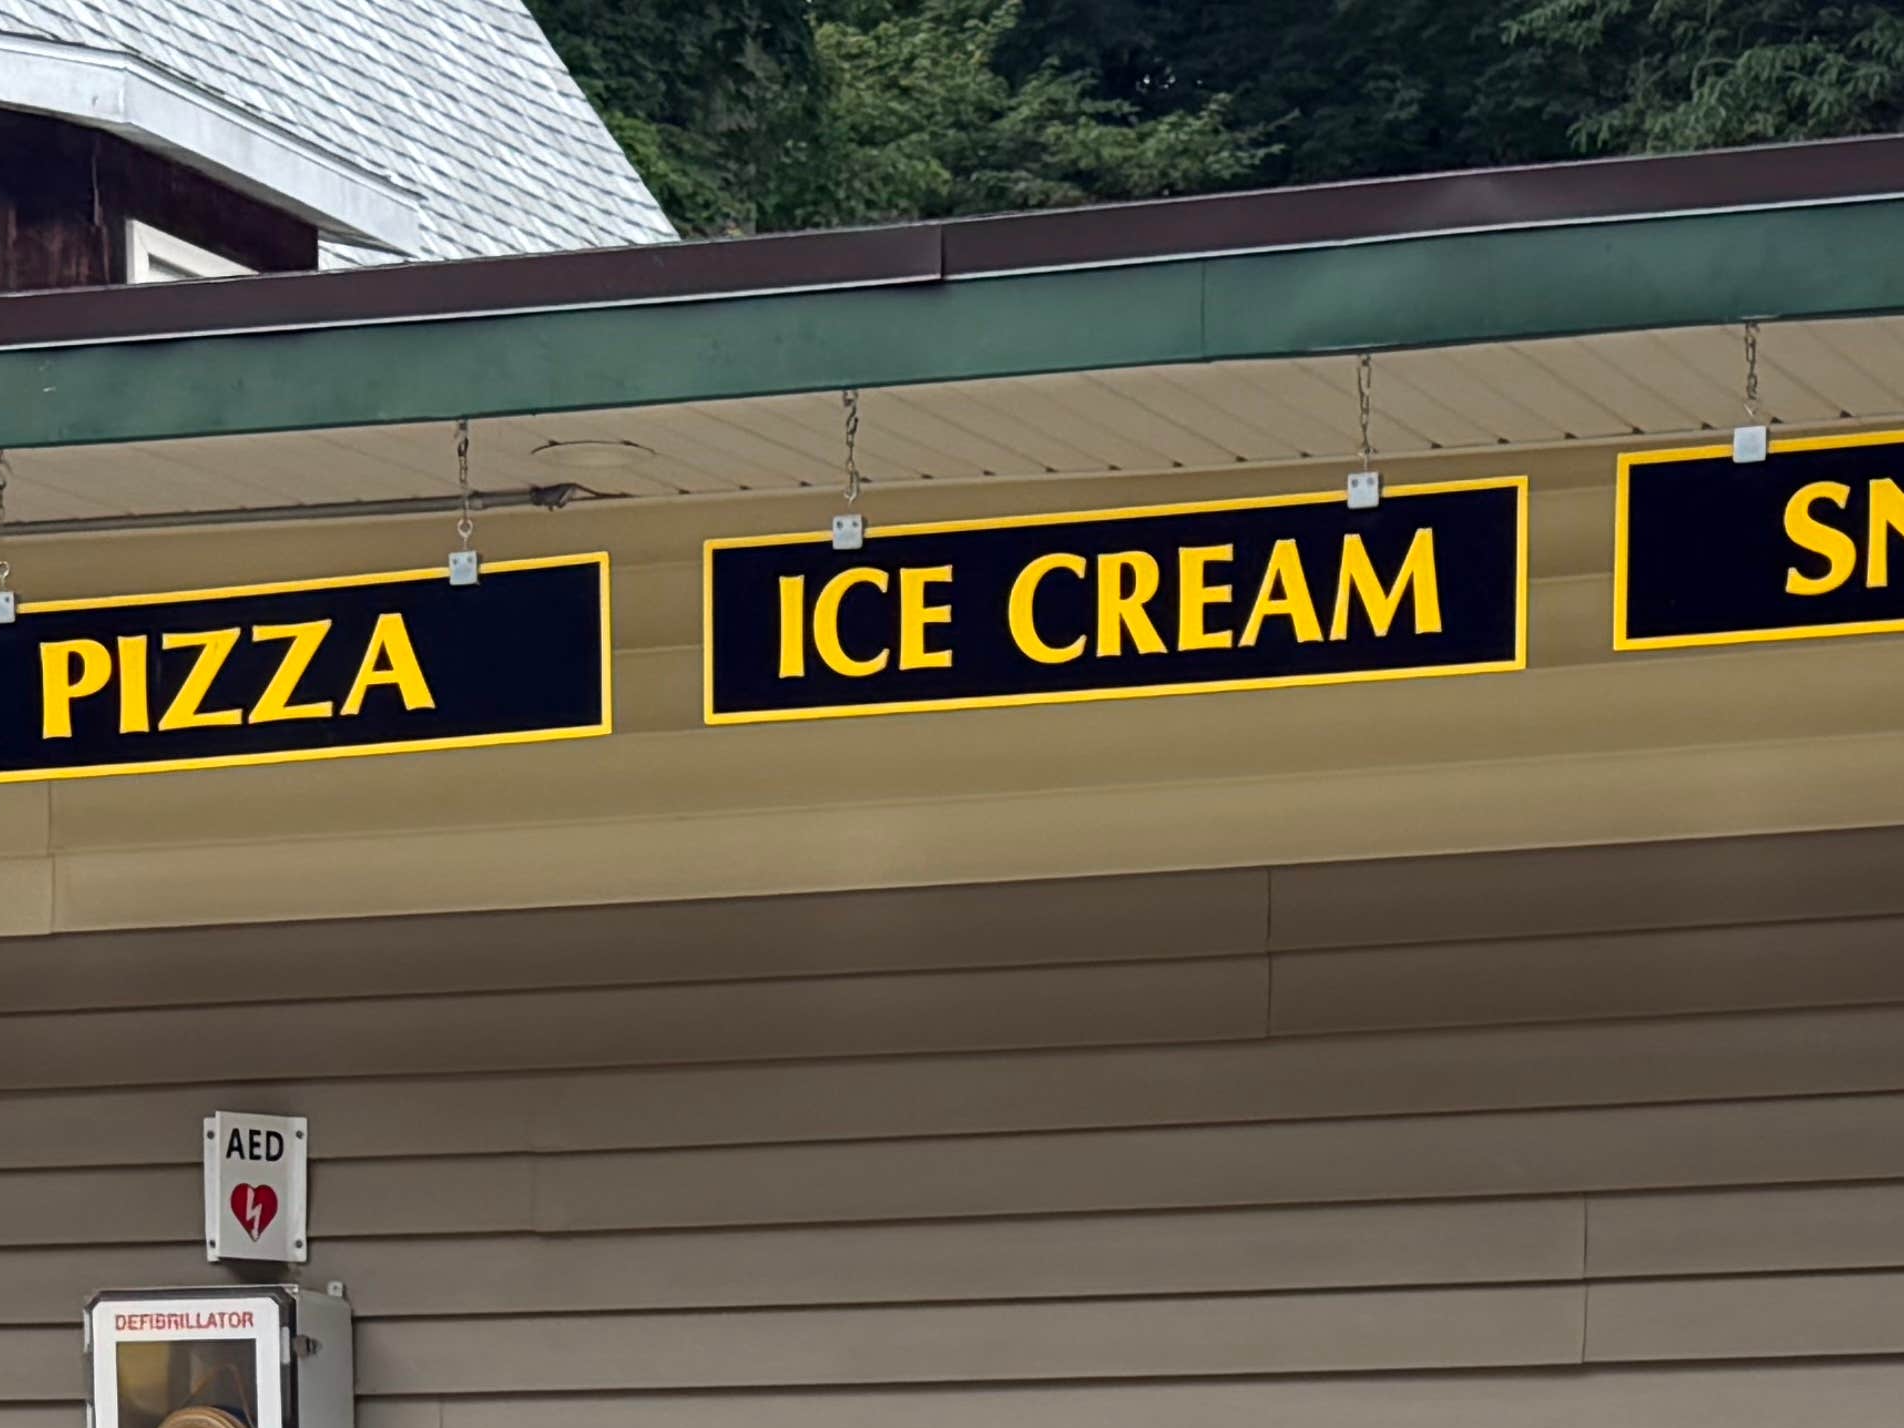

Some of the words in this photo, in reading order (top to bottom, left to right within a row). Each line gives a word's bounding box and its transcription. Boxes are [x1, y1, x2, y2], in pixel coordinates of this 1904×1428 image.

[778, 566, 953, 679] ICE
[1007, 527, 1443, 665] CREAM
[39, 611, 436, 740] PIZZA
[225, 1127, 285, 1162] AED
[114, 1311, 255, 1331] DEFIBRILLATOR
